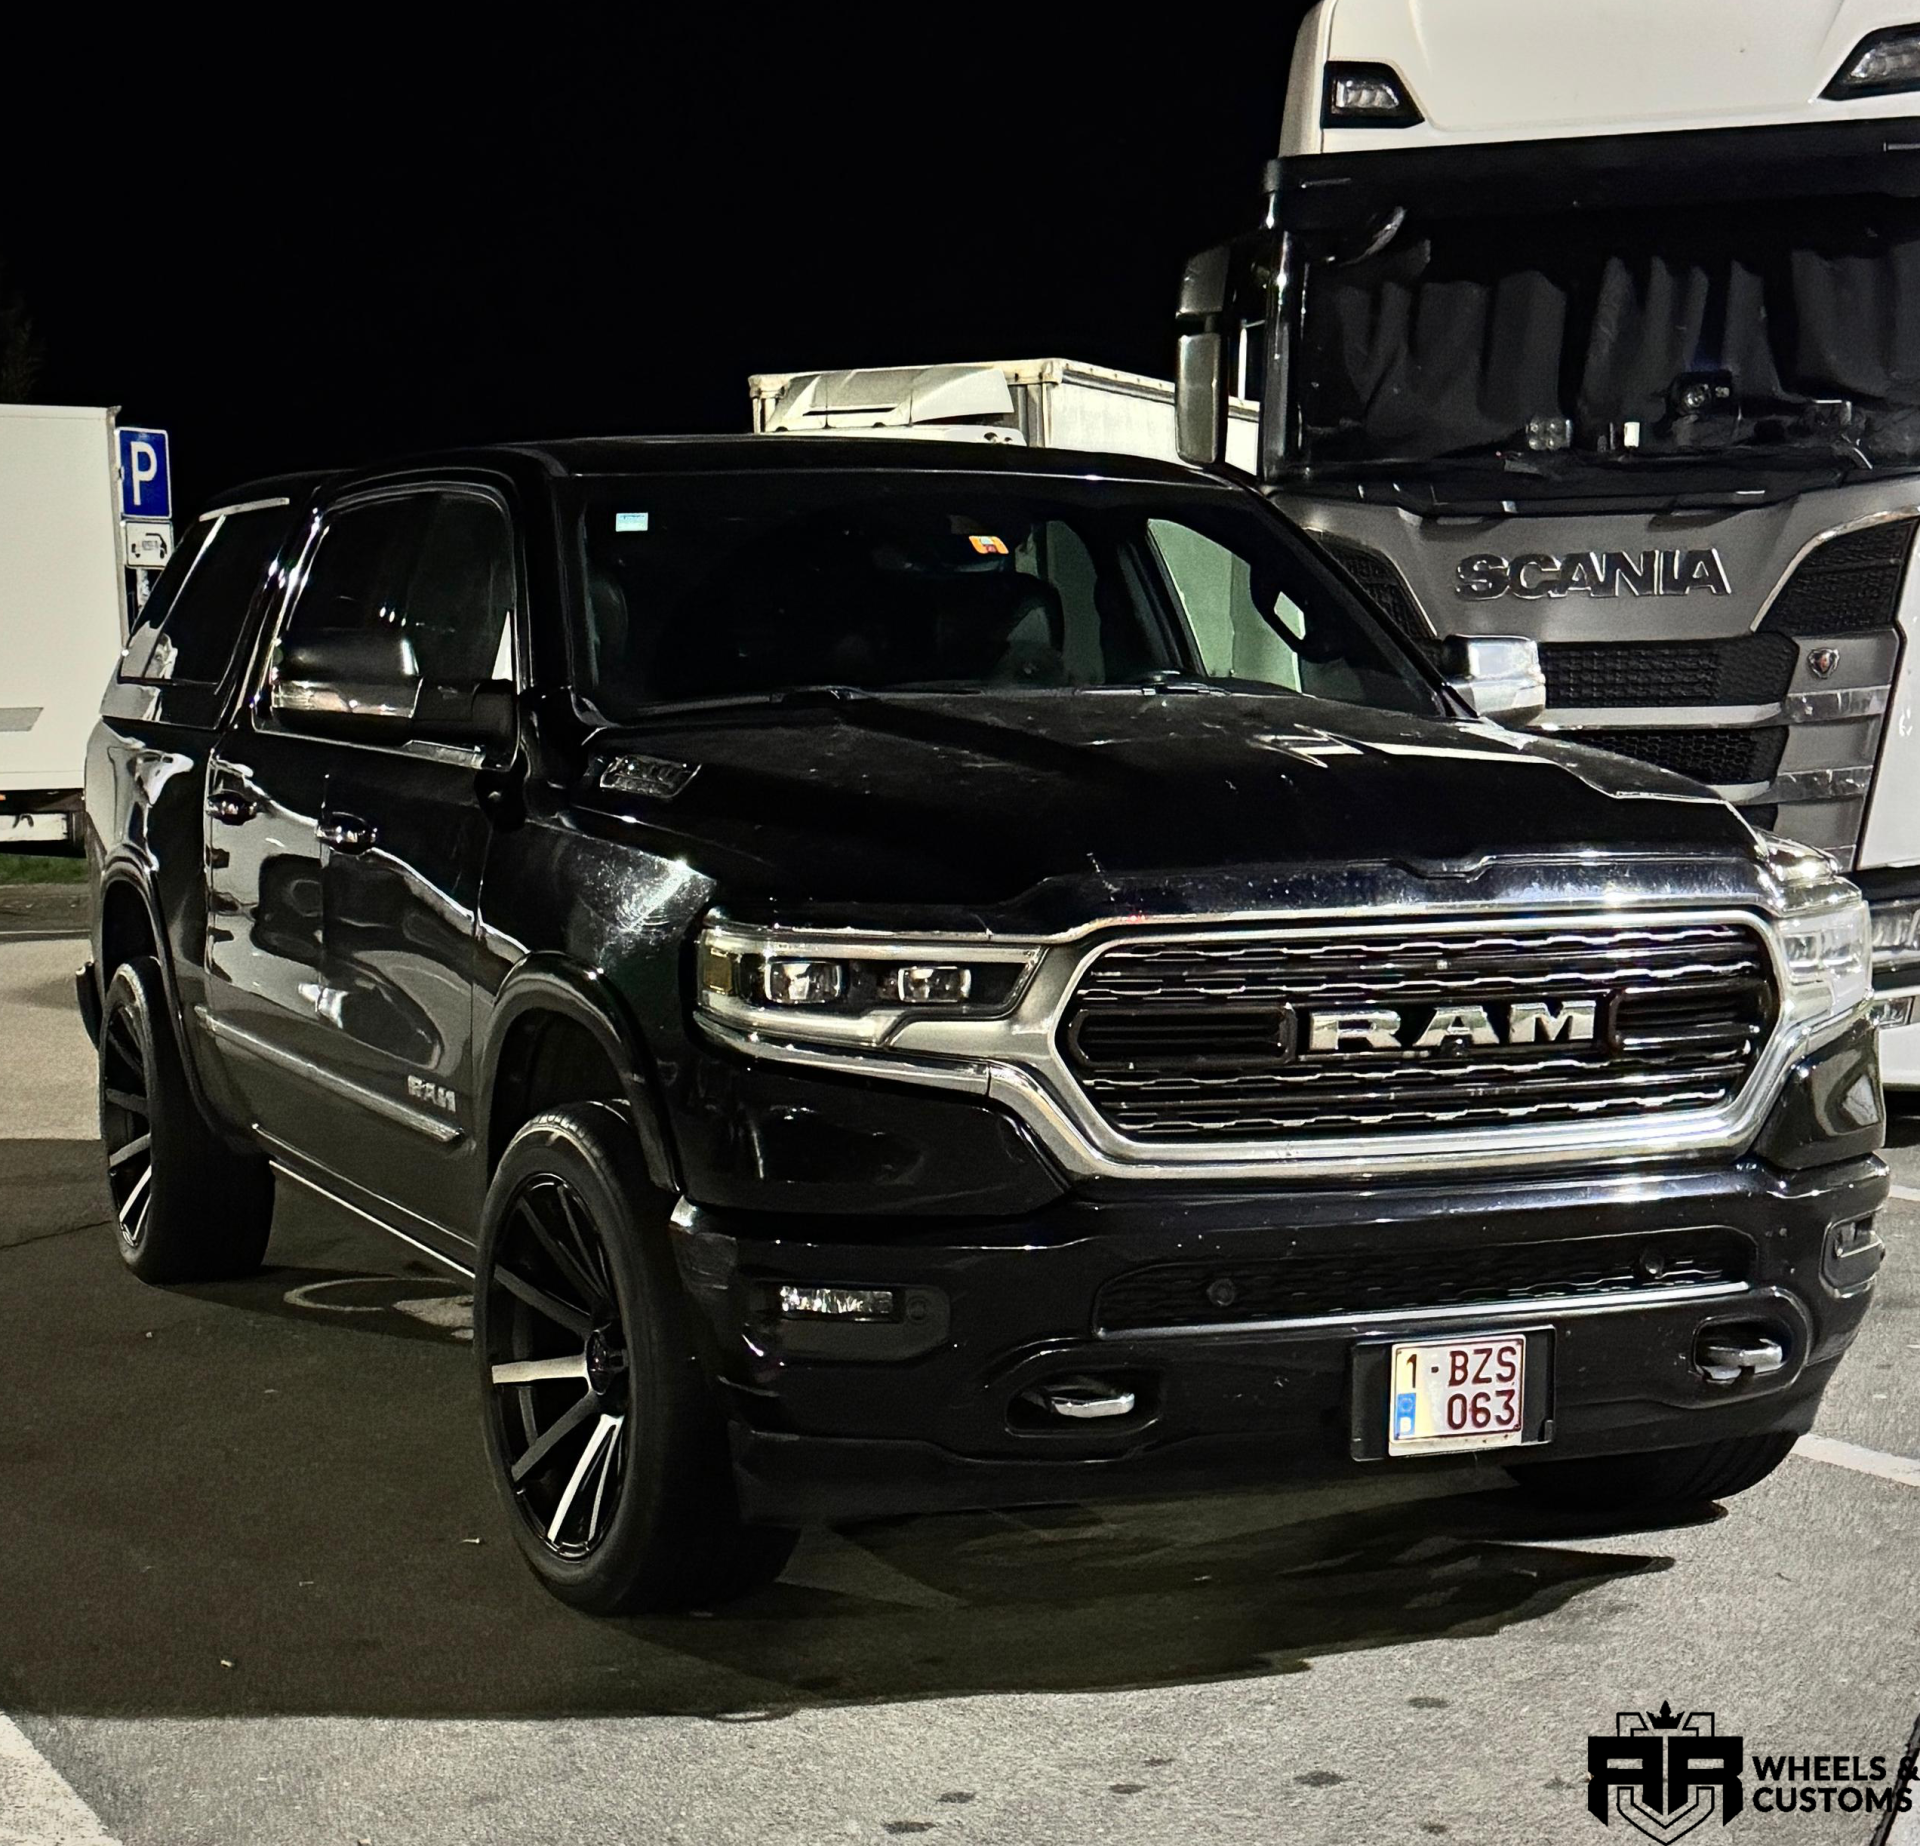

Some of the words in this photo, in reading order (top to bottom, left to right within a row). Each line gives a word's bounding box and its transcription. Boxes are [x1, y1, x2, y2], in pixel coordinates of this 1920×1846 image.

[130, 441, 158, 506] P
[1456, 548, 1732, 600] SCANIA
[1309, 1000, 1597, 1051] RAM
[1447, 1389, 1515, 1430] 063
